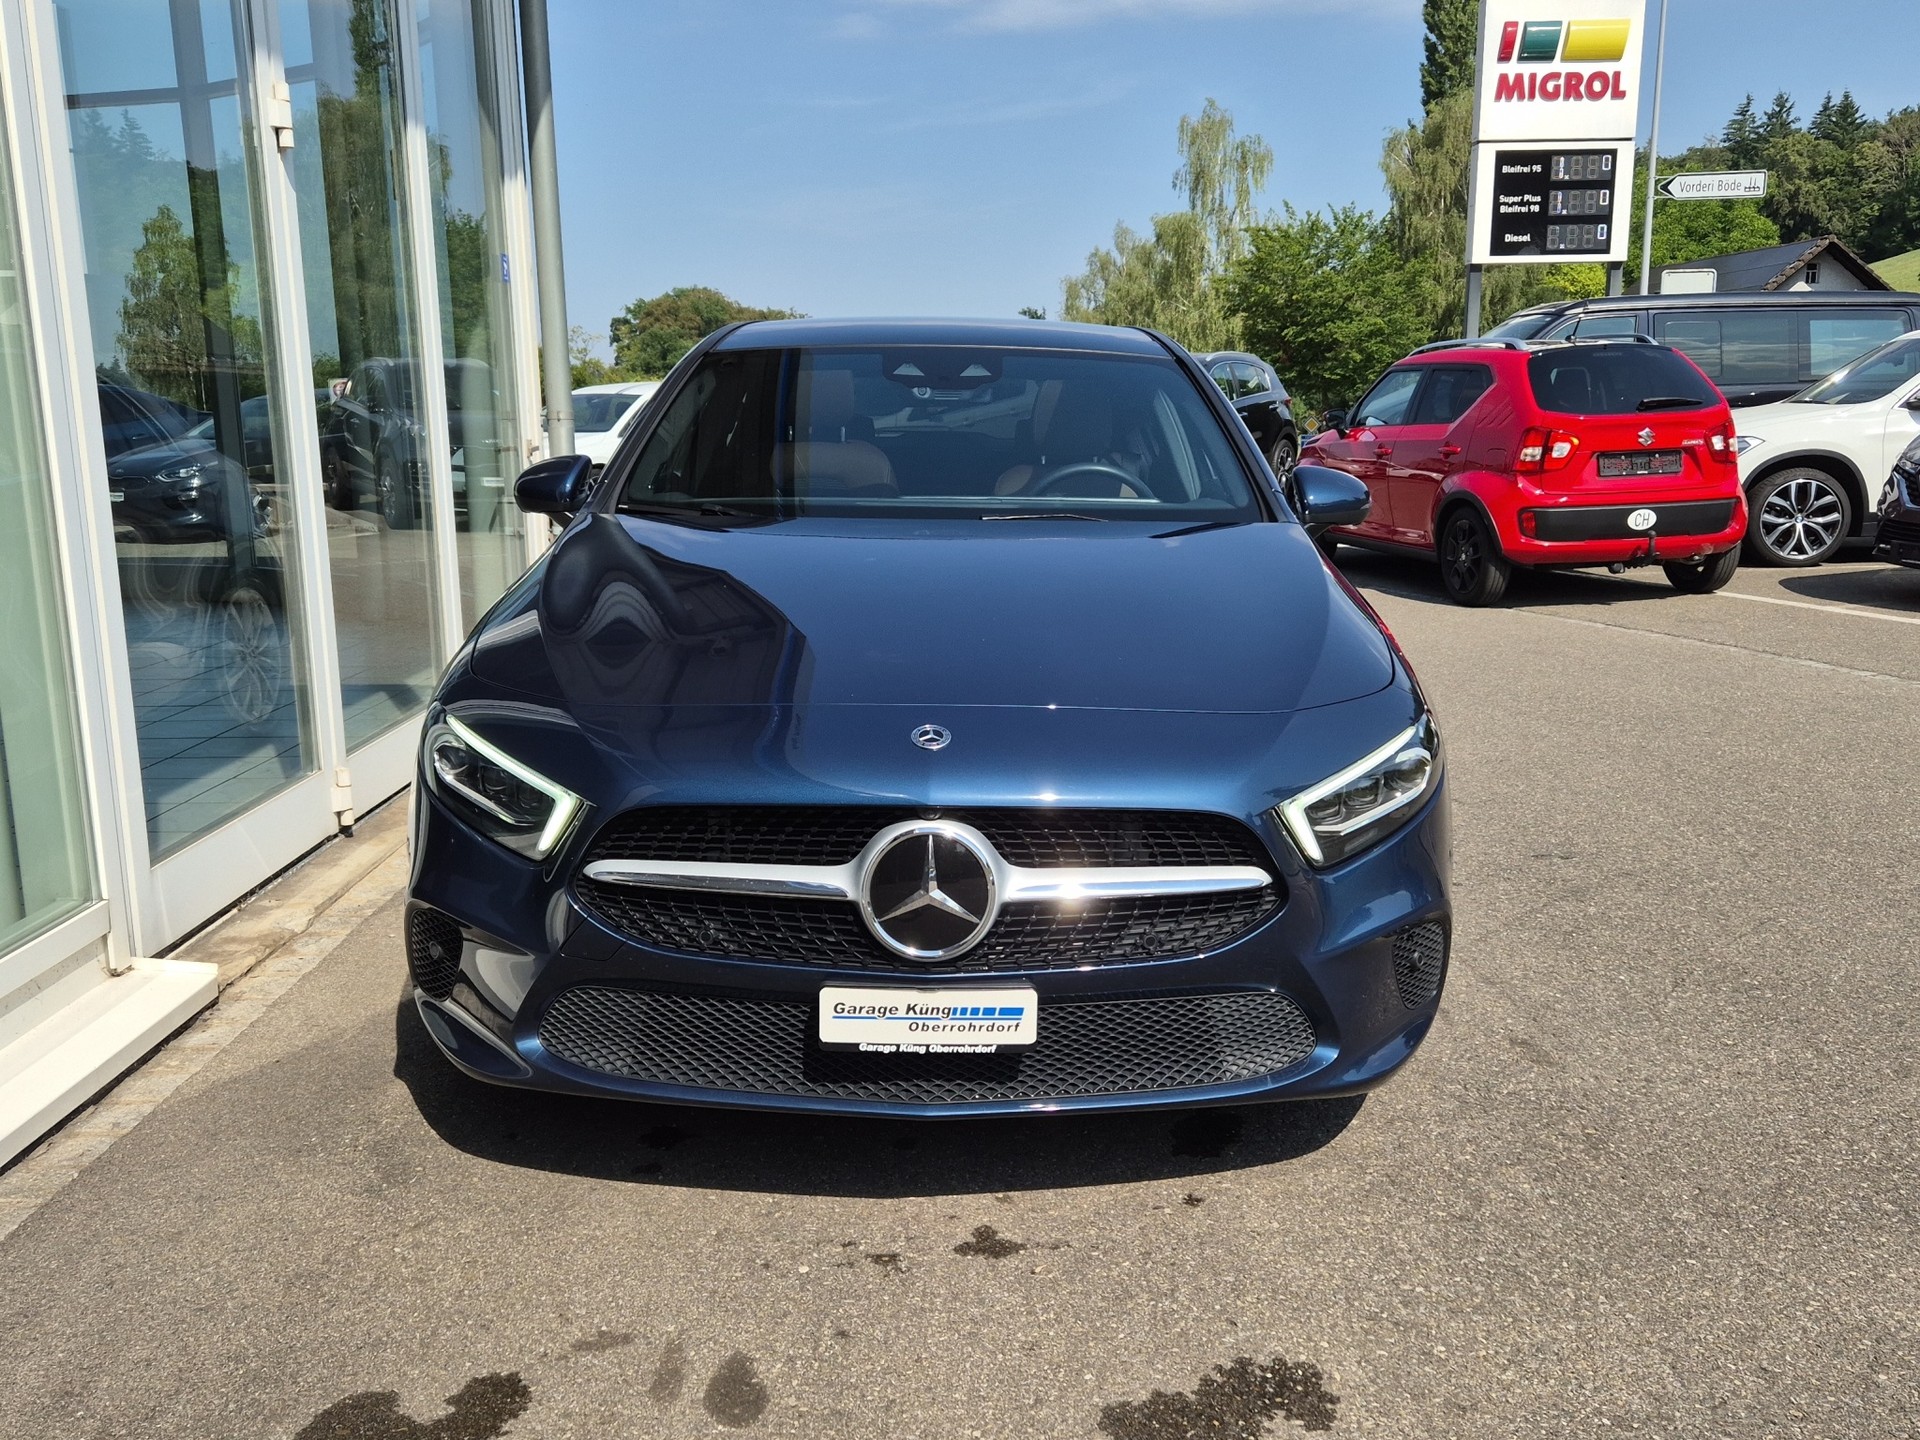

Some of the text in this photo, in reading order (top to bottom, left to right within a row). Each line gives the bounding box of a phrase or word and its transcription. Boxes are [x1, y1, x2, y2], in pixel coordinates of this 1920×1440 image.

[1494, 71, 1627, 102] MIGROL
[1502, 164, 1542, 174] Bleifrei 95
[1680, 178, 1742, 193] Vorderi Böde
[1499, 194, 1542, 204] Super Plus
[1500, 204, 1540, 213] Bleifrei 98
[1504, 233, 1531, 242] Diesel
[1634, 512, 1651, 527] CH
[833, 1002, 952, 1019] Garage Küng
[908, 1021, 1021, 1033] Oberrohrdorf
[859, 1042, 998, 1054] Garage Küng Oberrohrdorf
